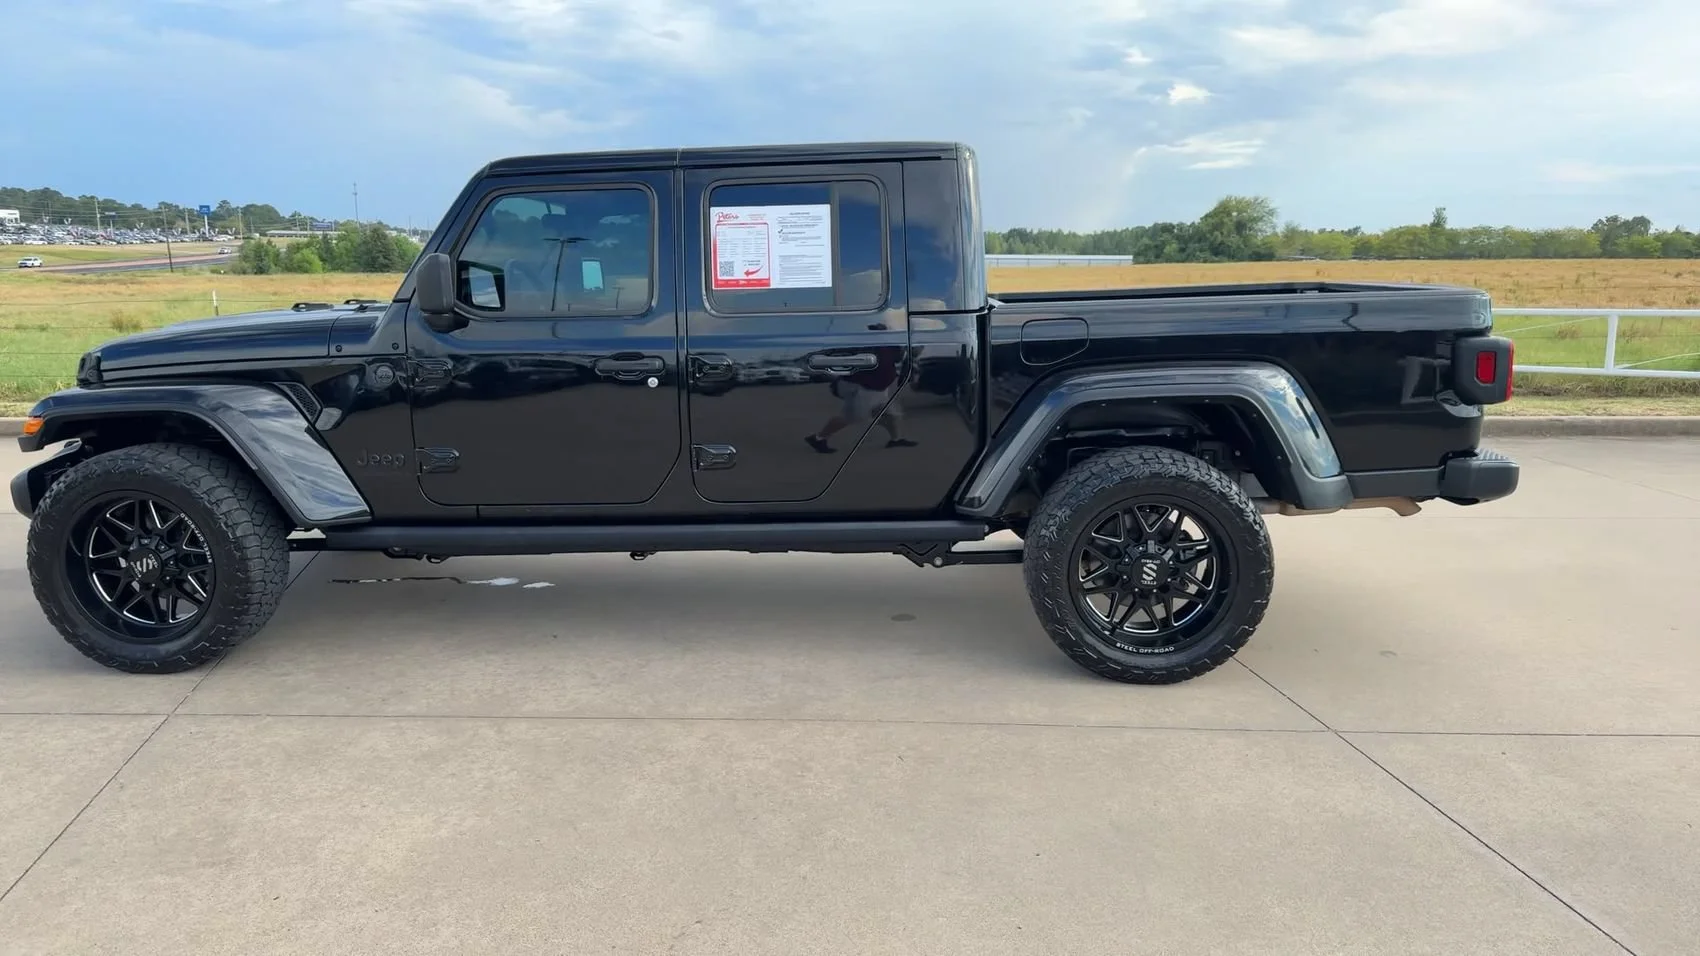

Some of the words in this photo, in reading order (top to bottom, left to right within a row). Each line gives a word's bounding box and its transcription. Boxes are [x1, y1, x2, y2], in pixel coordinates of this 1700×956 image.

[356, 447, 405, 467] Jeep
[180, 512, 204, 542] OFF-ROAD
[203, 542, 213, 563] STEEL
[1115, 642, 1138, 653] STEEL
